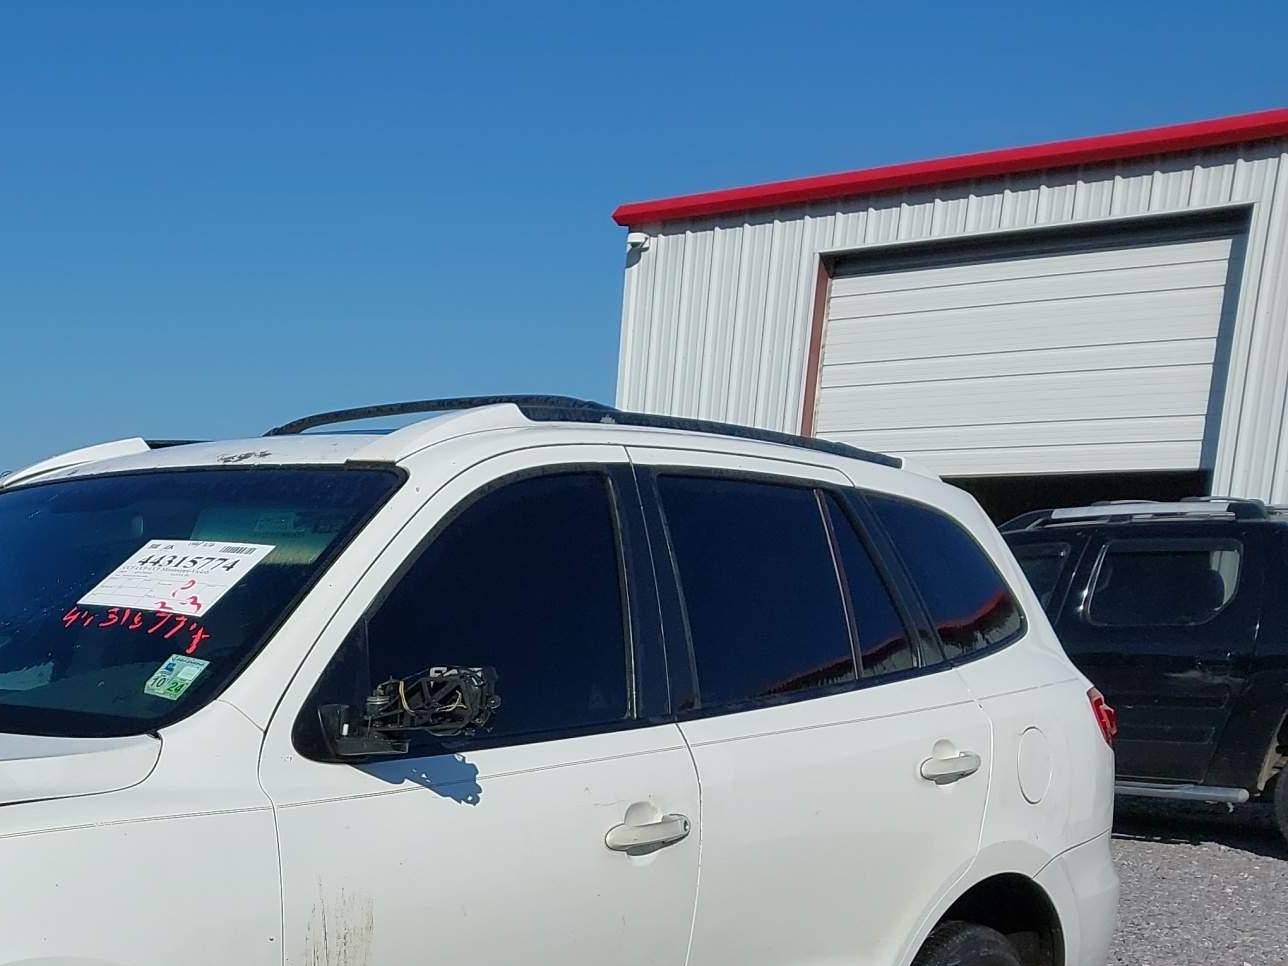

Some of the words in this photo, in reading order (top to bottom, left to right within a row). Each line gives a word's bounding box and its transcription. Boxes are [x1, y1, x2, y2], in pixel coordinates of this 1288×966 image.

[137, 553, 242, 572] 44315774
[150, 676, 167, 688] 10
[166, 681, 186, 693] 24
